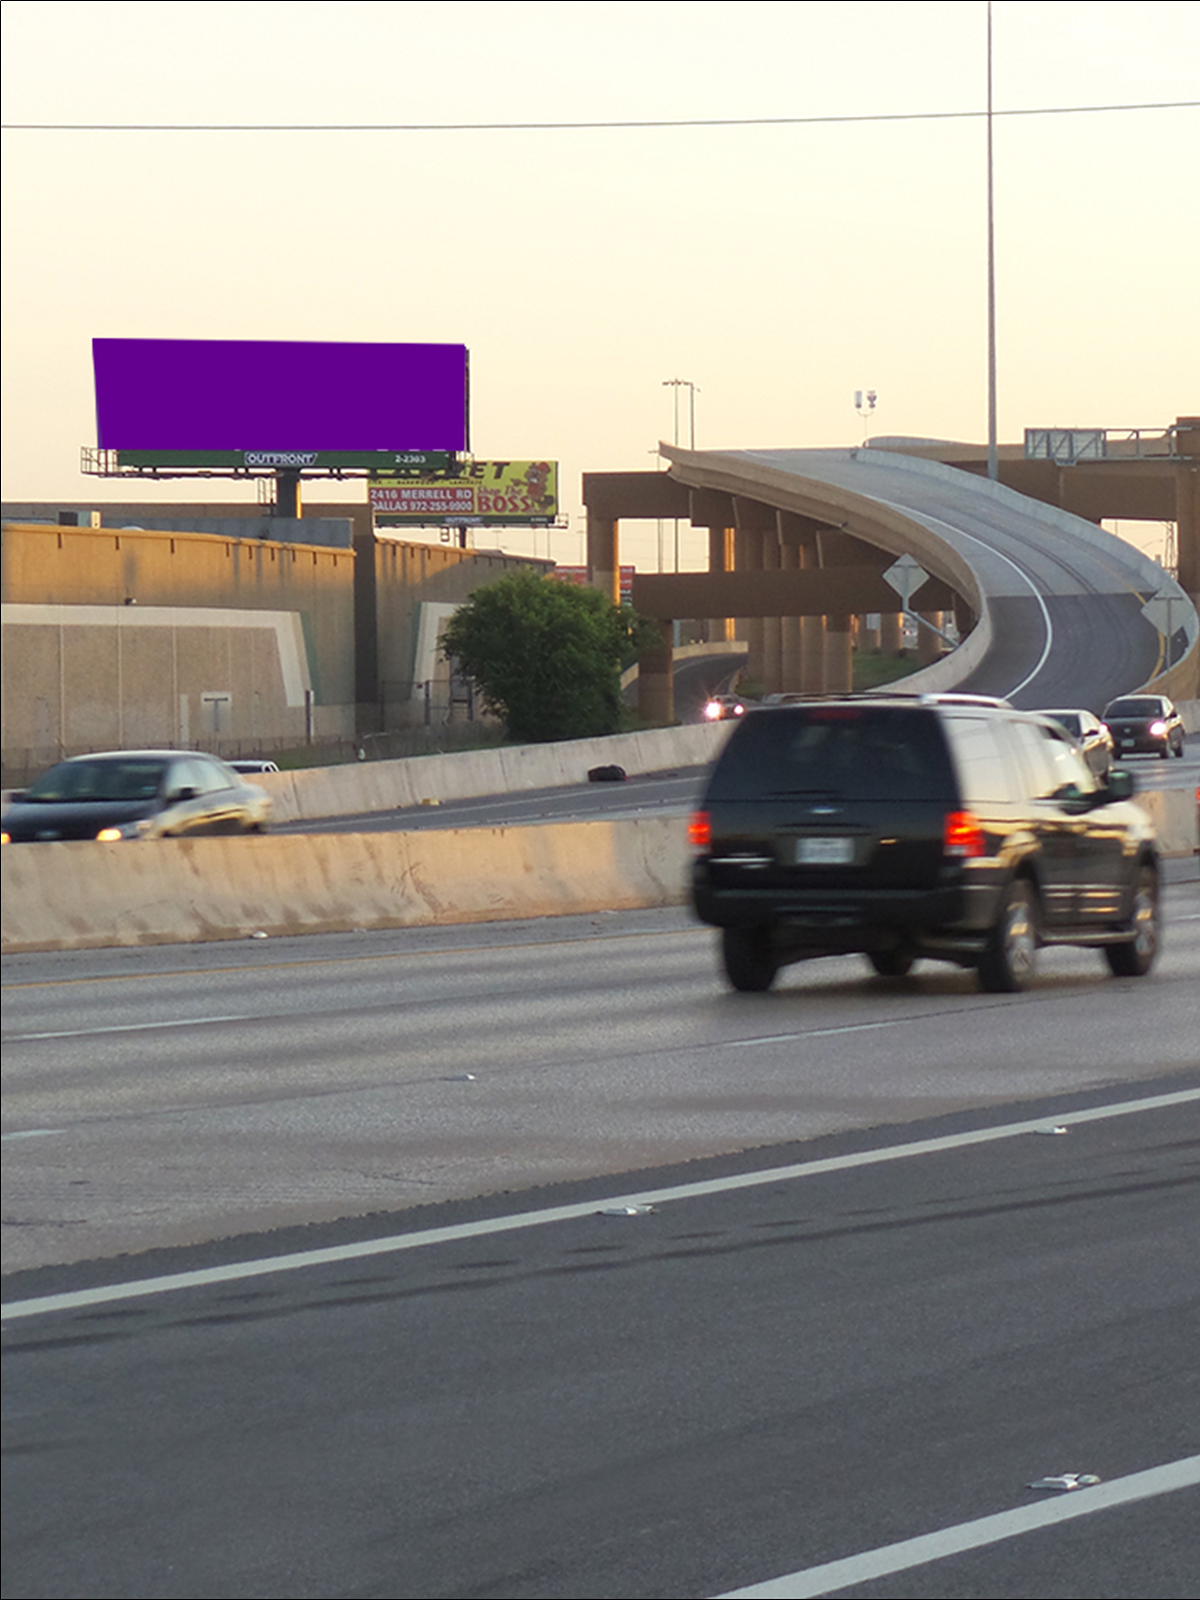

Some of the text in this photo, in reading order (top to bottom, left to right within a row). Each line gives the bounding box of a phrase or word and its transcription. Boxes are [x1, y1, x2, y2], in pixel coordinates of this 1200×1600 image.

[247, 453, 314, 464] OUTFRONT
[370, 489, 472, 499] 2416 MERRELL RD
[477, 495, 531, 512] BOSS
